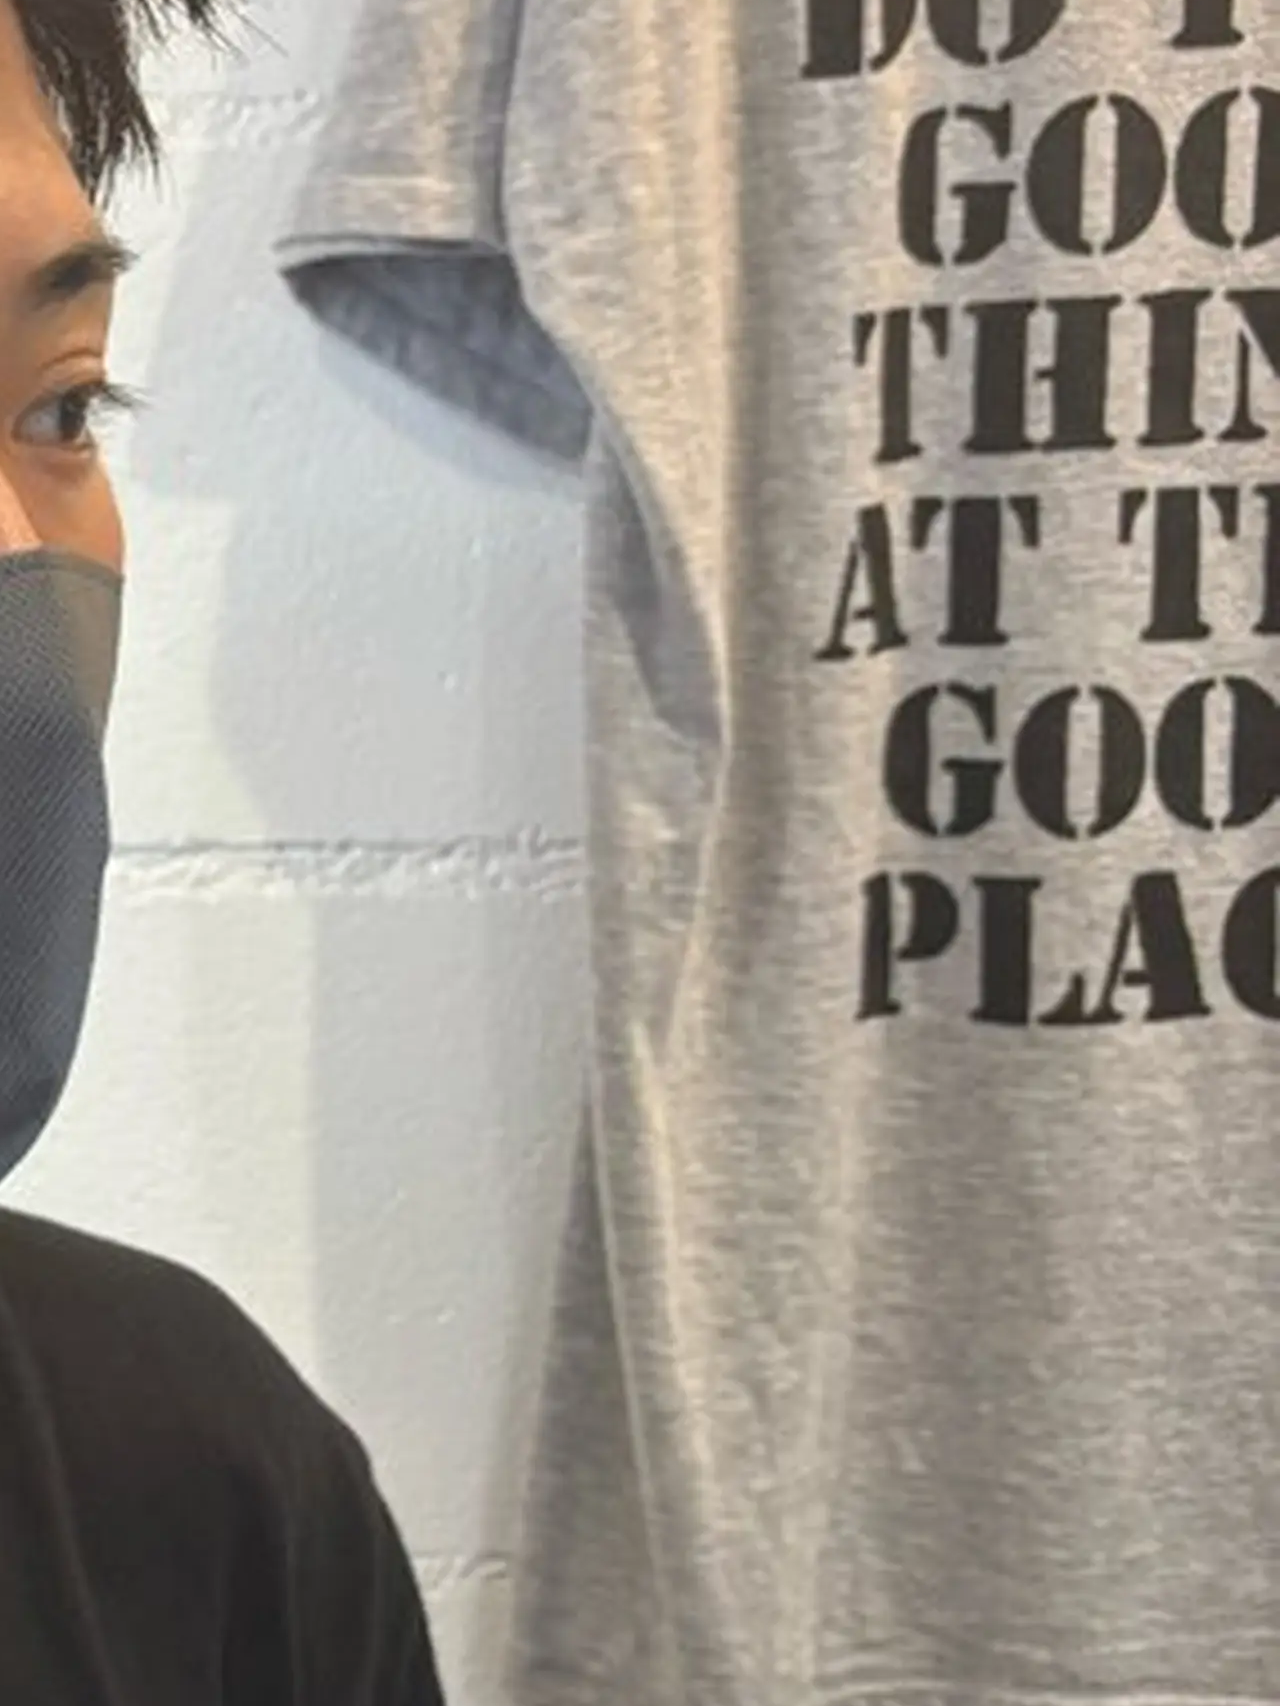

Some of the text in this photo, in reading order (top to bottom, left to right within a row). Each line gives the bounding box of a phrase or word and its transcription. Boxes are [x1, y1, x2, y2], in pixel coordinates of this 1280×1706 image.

[898, 86, 1280, 267] GOO
[814, 482, 1280, 661] AT T
[883, 675, 1280, 840] GOO
